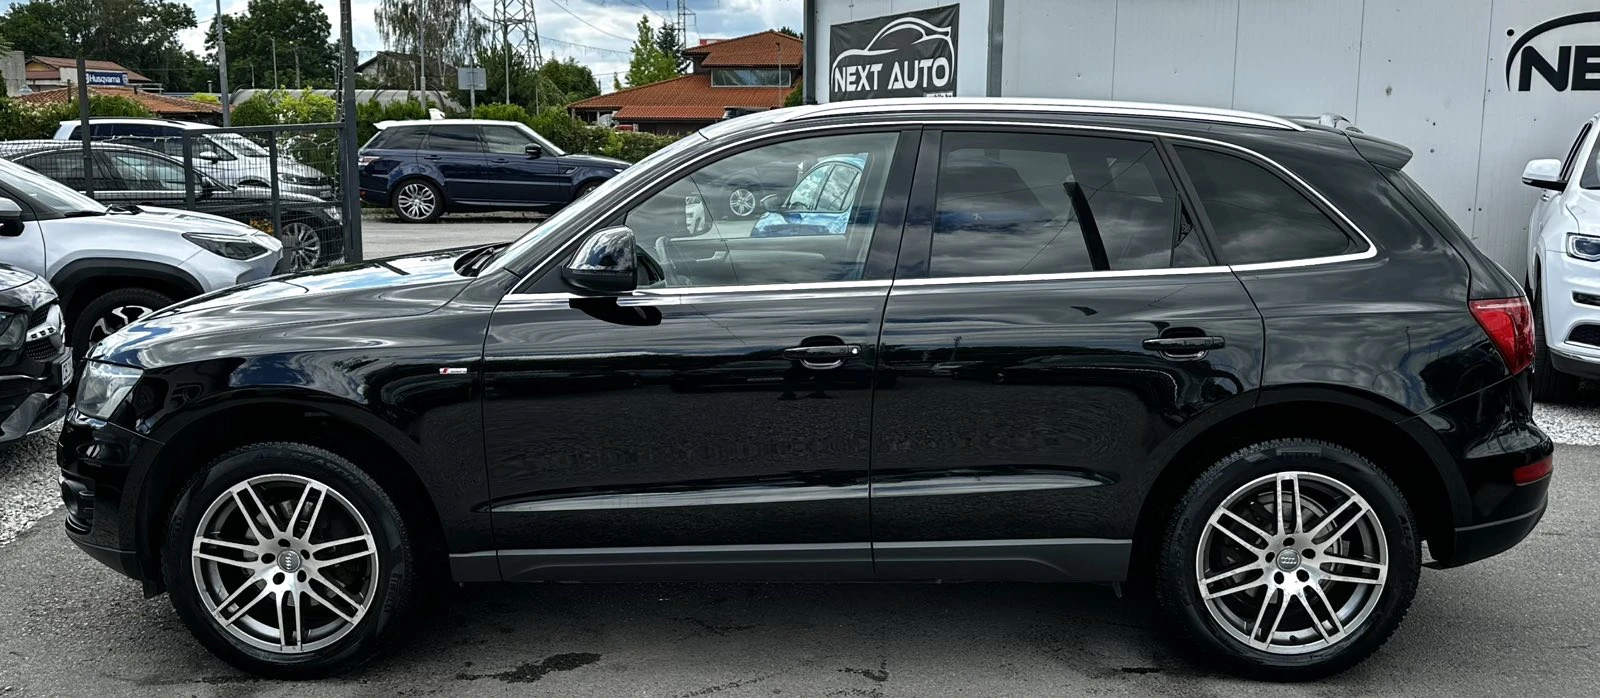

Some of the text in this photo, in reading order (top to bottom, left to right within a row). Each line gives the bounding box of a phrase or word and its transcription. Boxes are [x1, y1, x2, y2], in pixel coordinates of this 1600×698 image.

[91, 74, 120, 84] Husqvarna
[834, 57, 950, 93] NEXT AUTO
